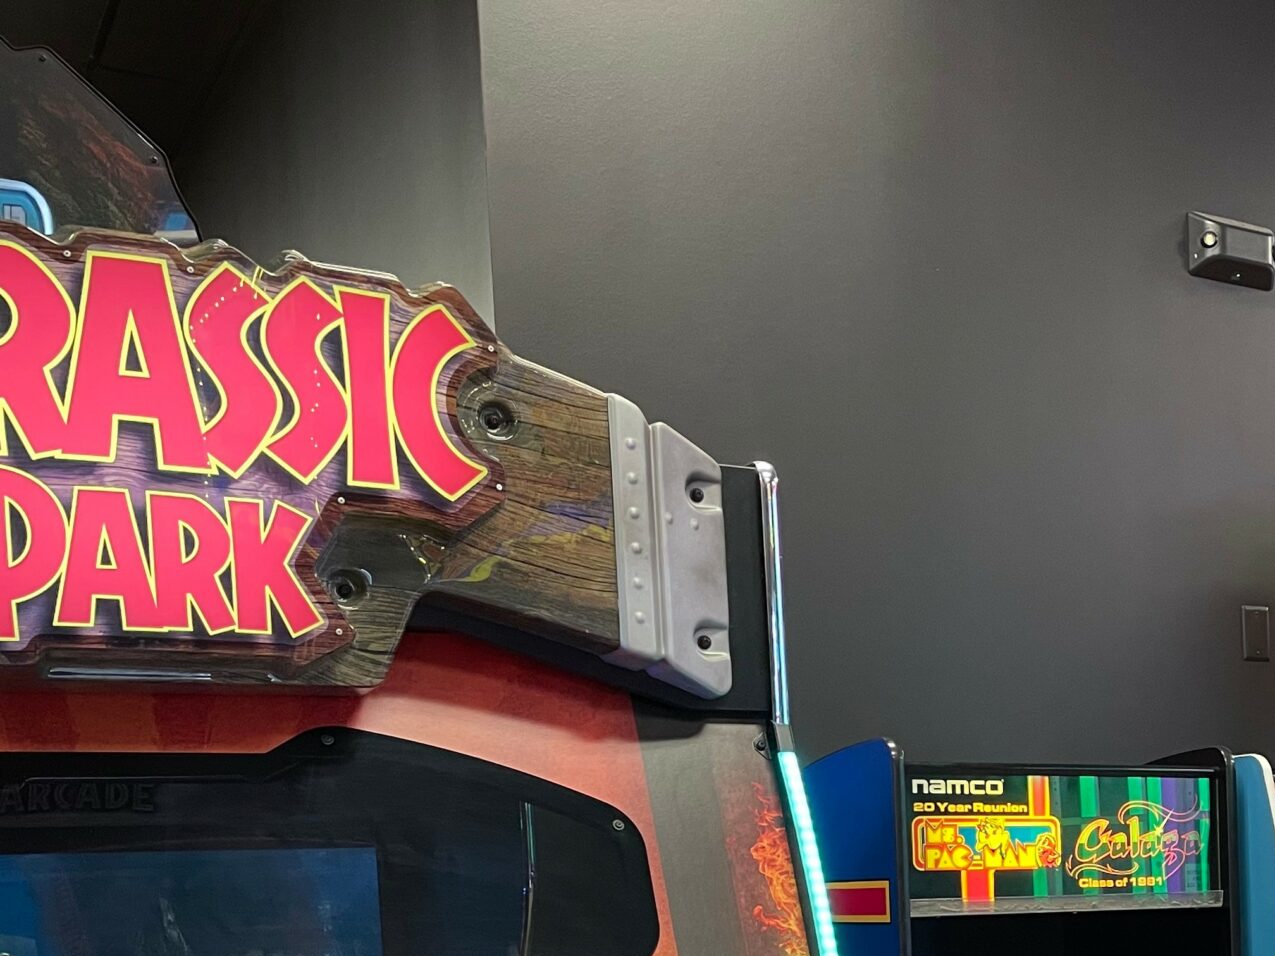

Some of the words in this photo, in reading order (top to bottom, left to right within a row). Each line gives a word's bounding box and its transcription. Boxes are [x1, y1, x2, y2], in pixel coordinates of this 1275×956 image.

[0, 464, 327, 641] PARK
[911, 778, 1004, 795] namco
[913, 803, 934, 812] 20
[936, 802, 972, 812] Year
[972, 803, 1028, 813] Reunion
[925, 819, 963, 844] Ms.
[925, 842, 1038, 869] PAC-MAN
[1074, 815, 1205, 880] Galaga
[1079, 878, 1115, 888] Class
[1116, 877, 1129, 888] of
